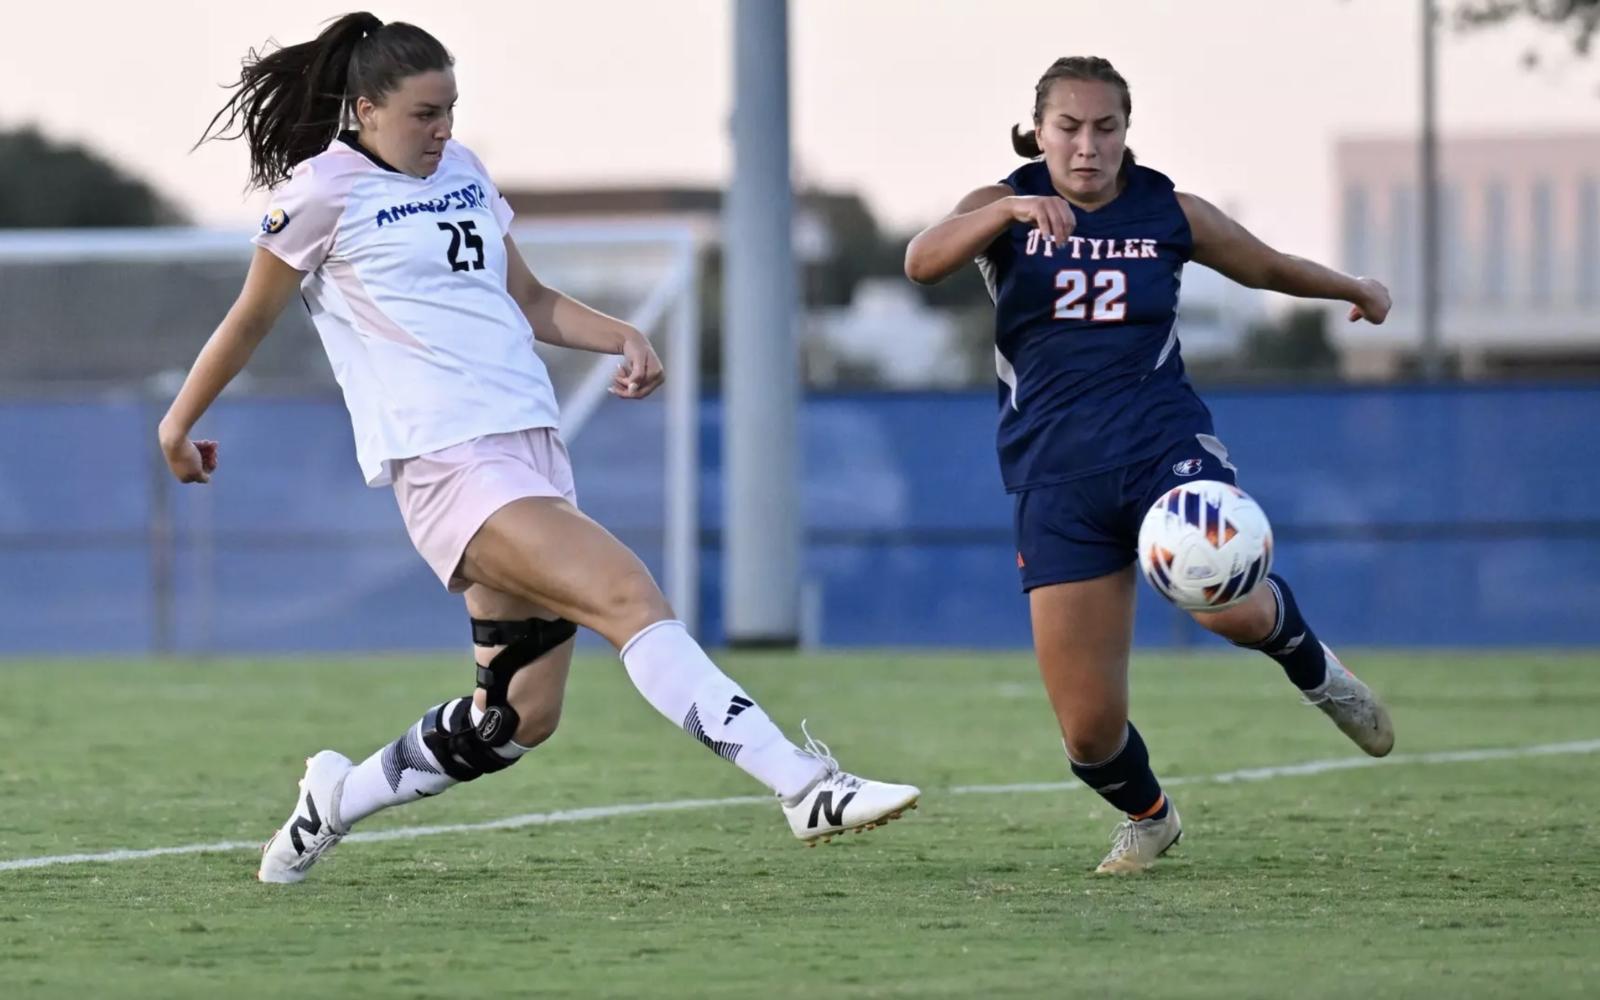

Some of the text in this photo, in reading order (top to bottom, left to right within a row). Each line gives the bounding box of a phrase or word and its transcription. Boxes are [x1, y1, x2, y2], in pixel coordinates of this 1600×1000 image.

[436, 220, 485, 272] 25
[1025, 228, 1158, 260] UT TYLER
[1053, 268, 1127, 321] 22
[807, 790, 857, 829] N
